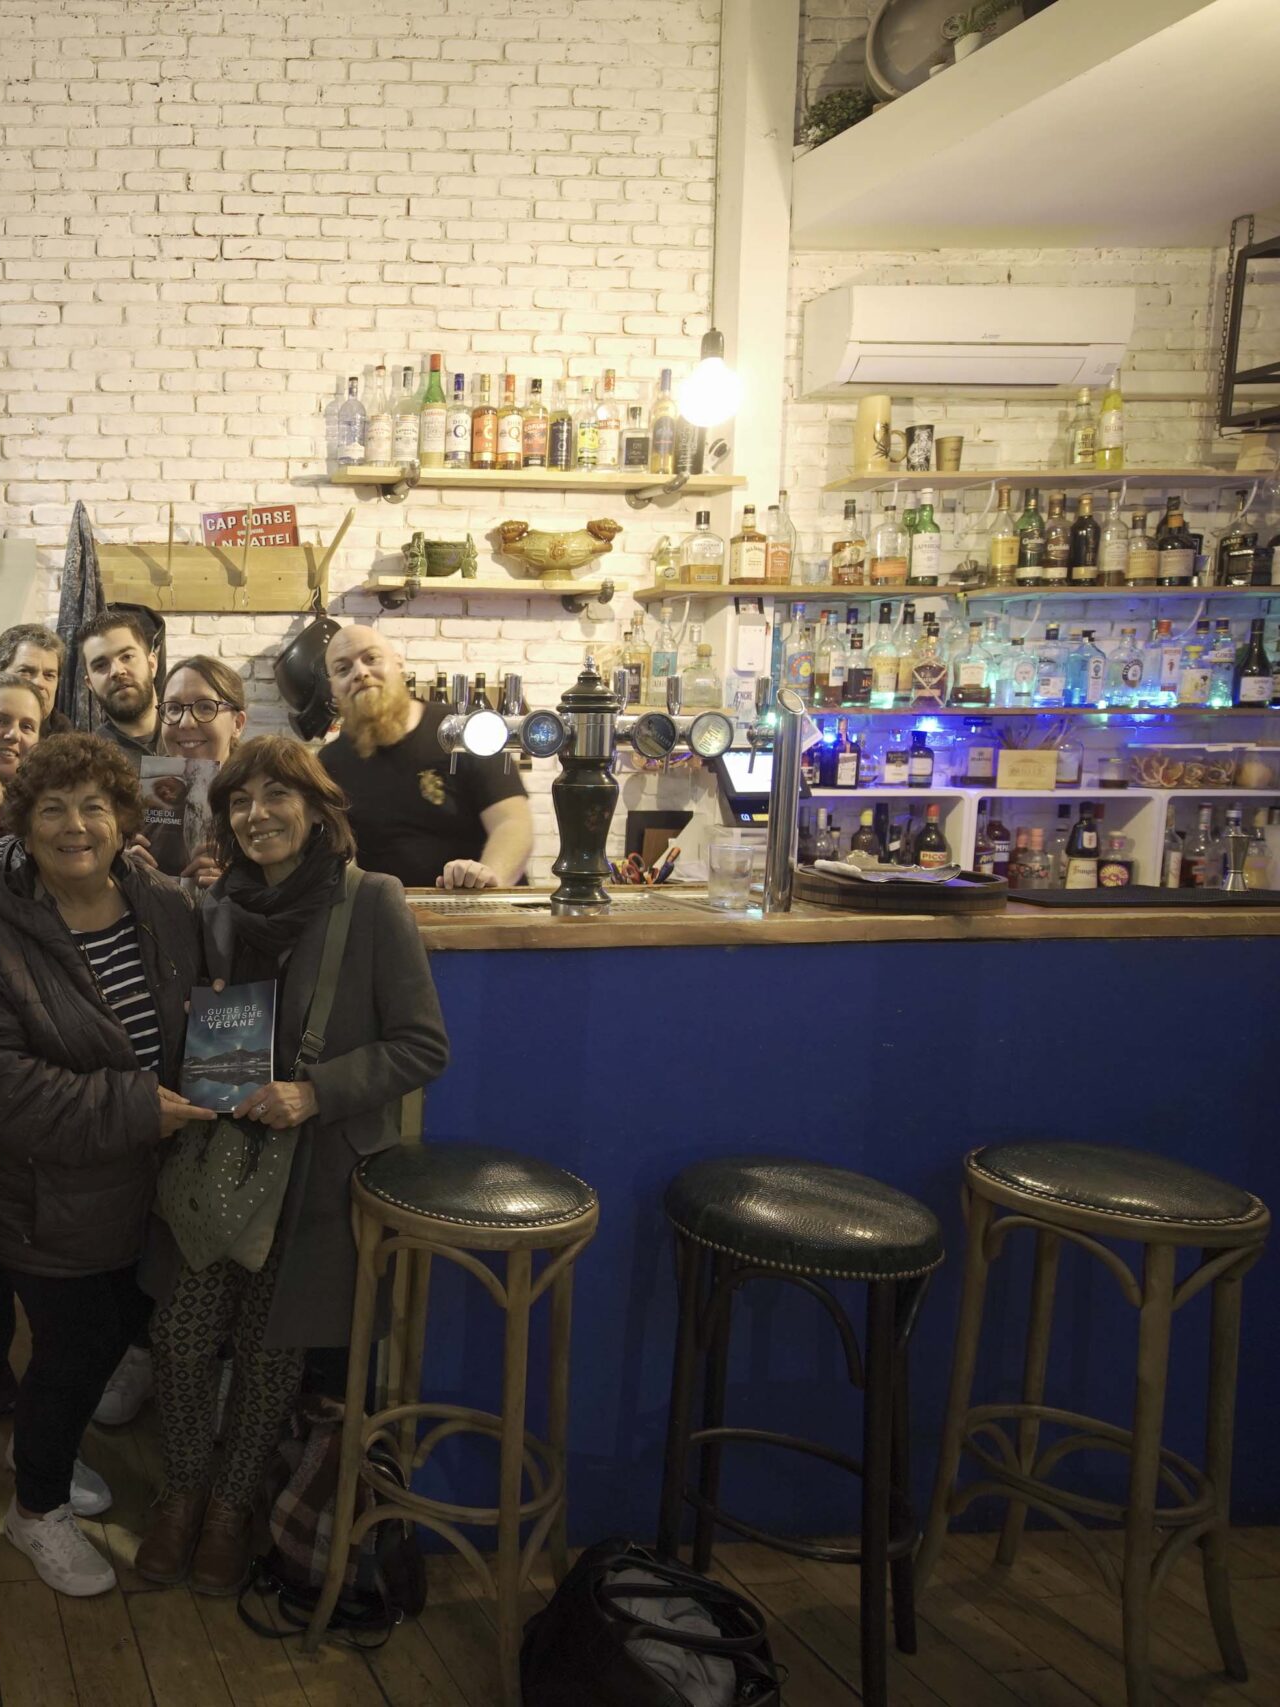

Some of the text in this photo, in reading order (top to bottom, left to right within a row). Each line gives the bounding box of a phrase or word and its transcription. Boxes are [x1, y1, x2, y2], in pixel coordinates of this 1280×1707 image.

[206, 510, 292, 531] CAP CORSE
[164, 810, 175, 818] DU
[200, 1010, 263, 1022] L'ACTIVISME
[208, 1004, 258, 1016] GUIDE DE
